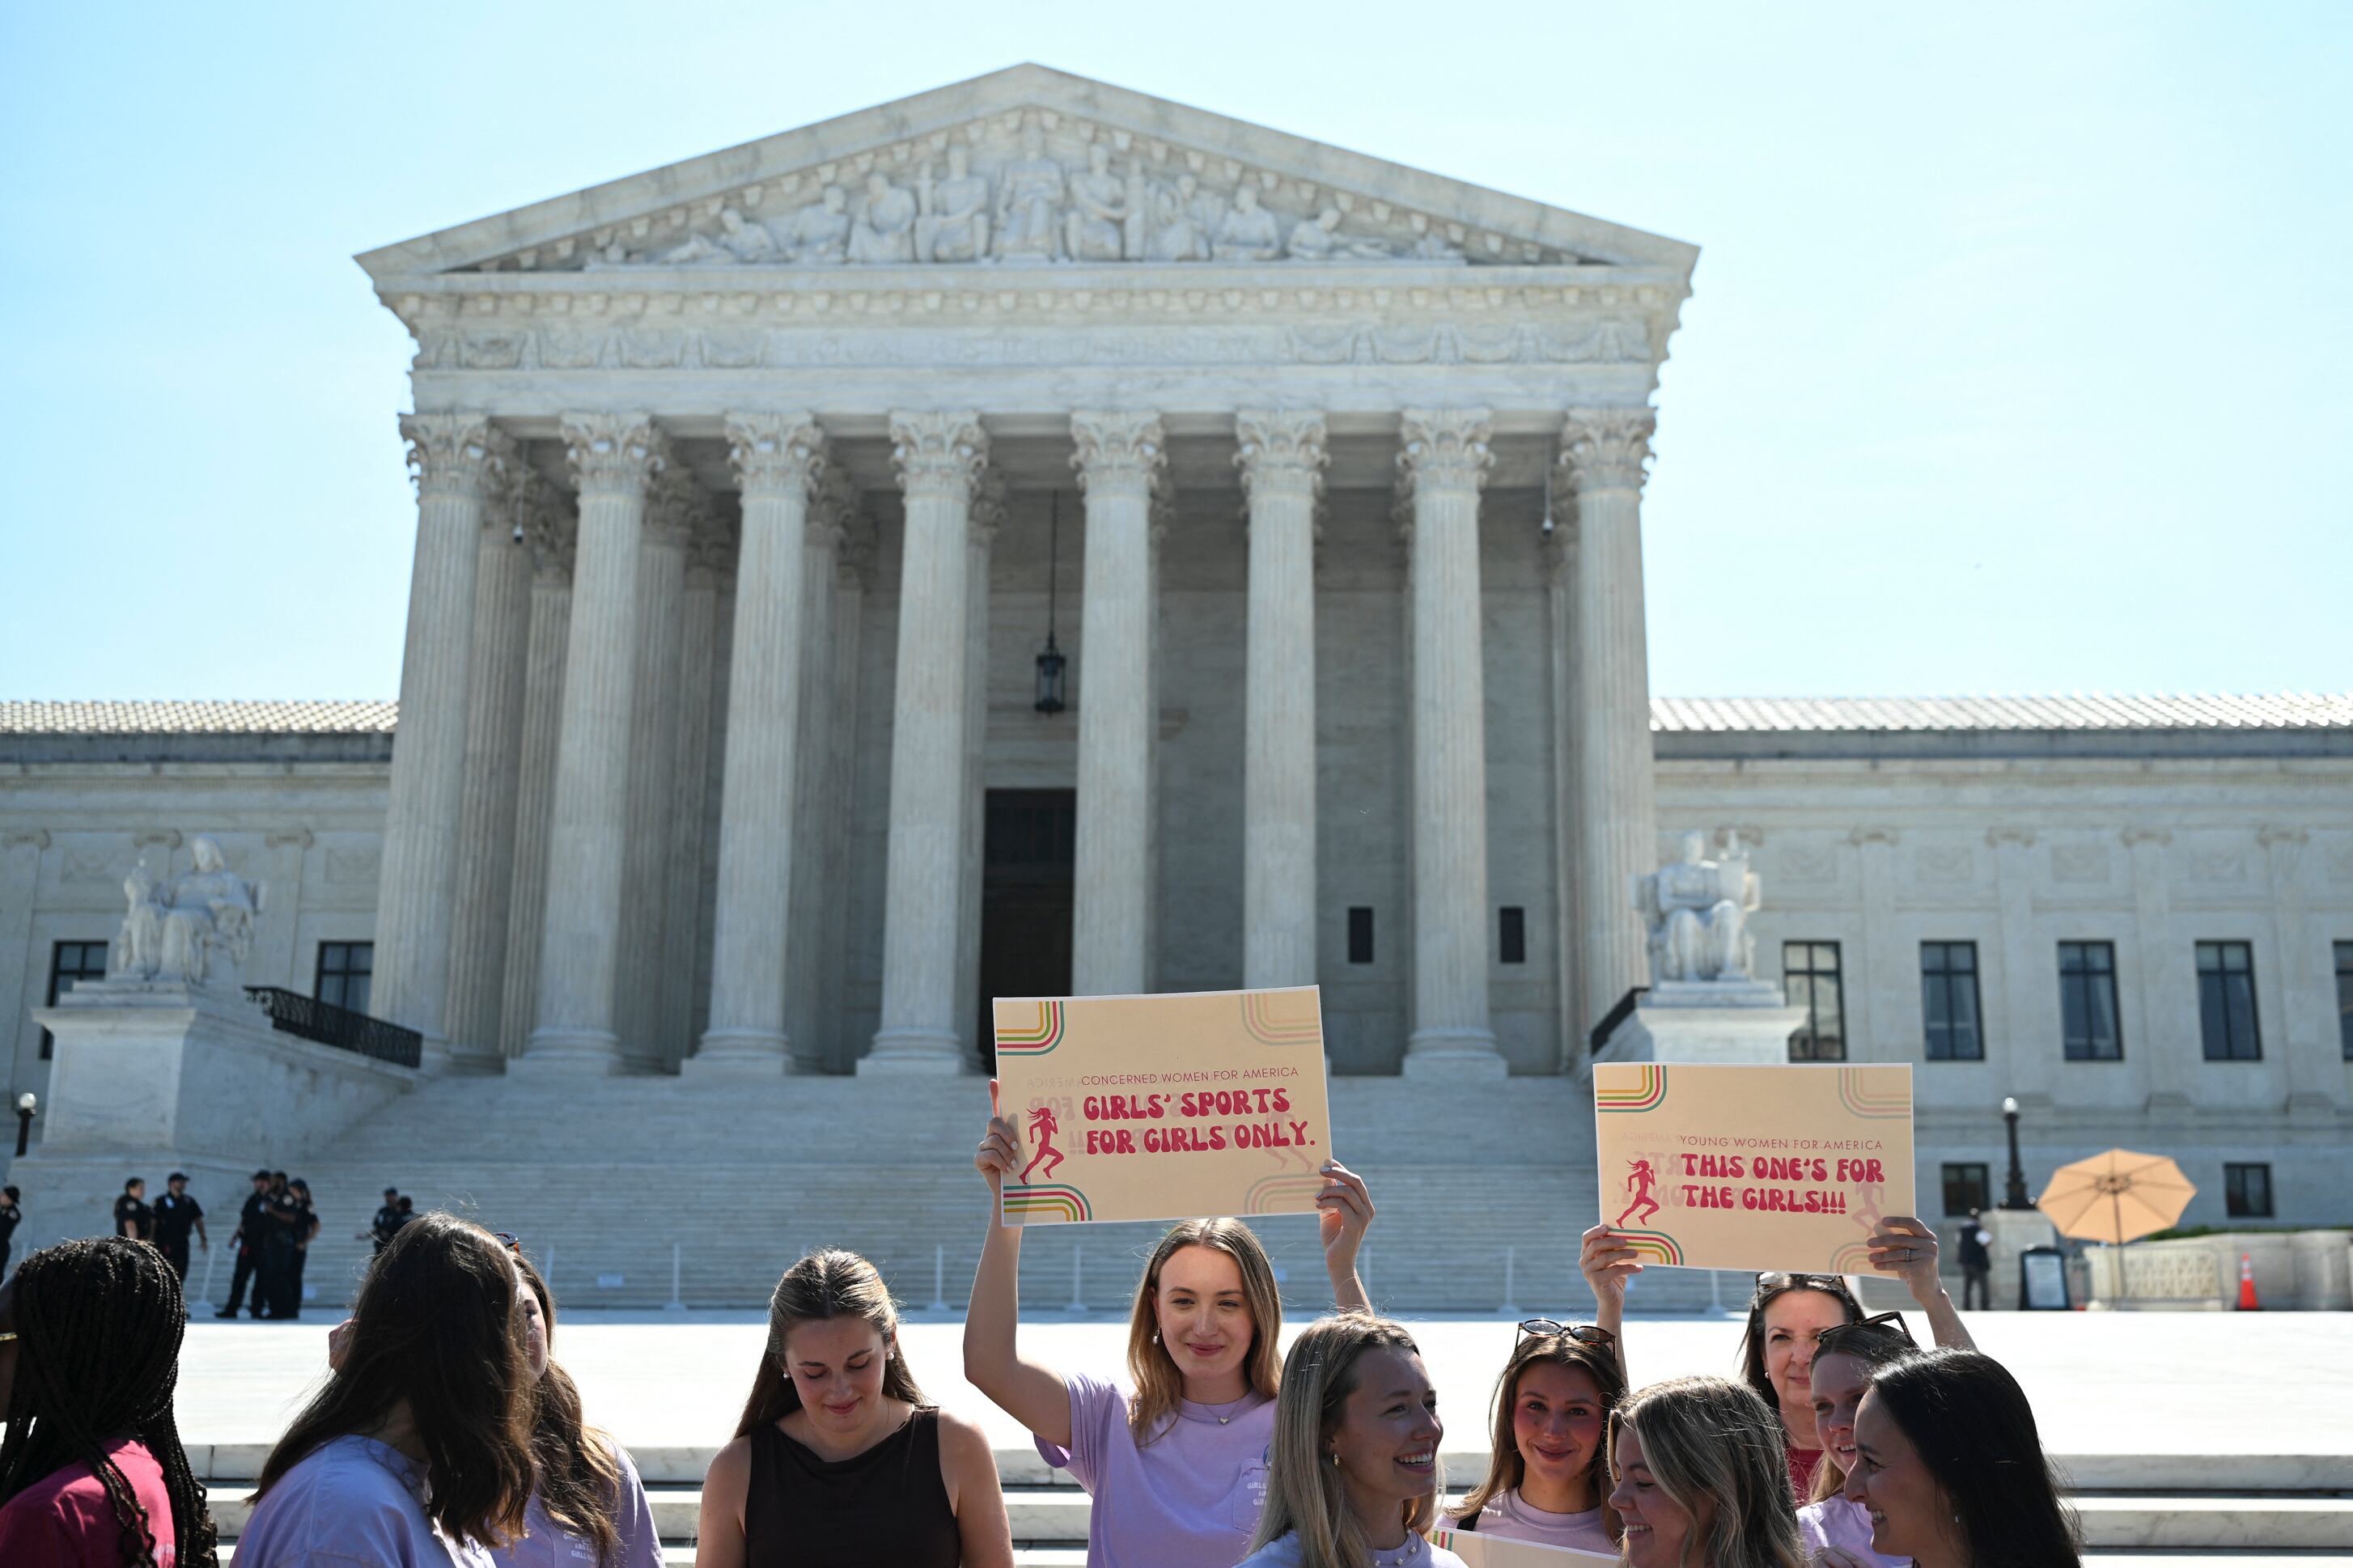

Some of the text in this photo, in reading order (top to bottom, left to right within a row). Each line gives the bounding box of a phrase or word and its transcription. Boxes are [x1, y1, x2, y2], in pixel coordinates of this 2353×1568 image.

[1081, 1066, 1299, 1086] CONCERNED WOMEN FOR AMERICA
[1083, 1087, 1291, 1121] GIRLS' SPORTS
[1087, 1129, 1136, 1155] FOR
[1143, 1125, 1227, 1153] GIRLS
[1235, 1121, 1316, 1150] ONLY.
[1681, 1134, 1883, 1151] YOUNG WOMEN FOR AMERICA
[1681, 1153, 1745, 1179] THIS
[1753, 1156, 1828, 1182] ONE'S
[1837, 1158, 1885, 1183] FOR
[1681, 1184, 1846, 1215] THE GIRLS!!!
